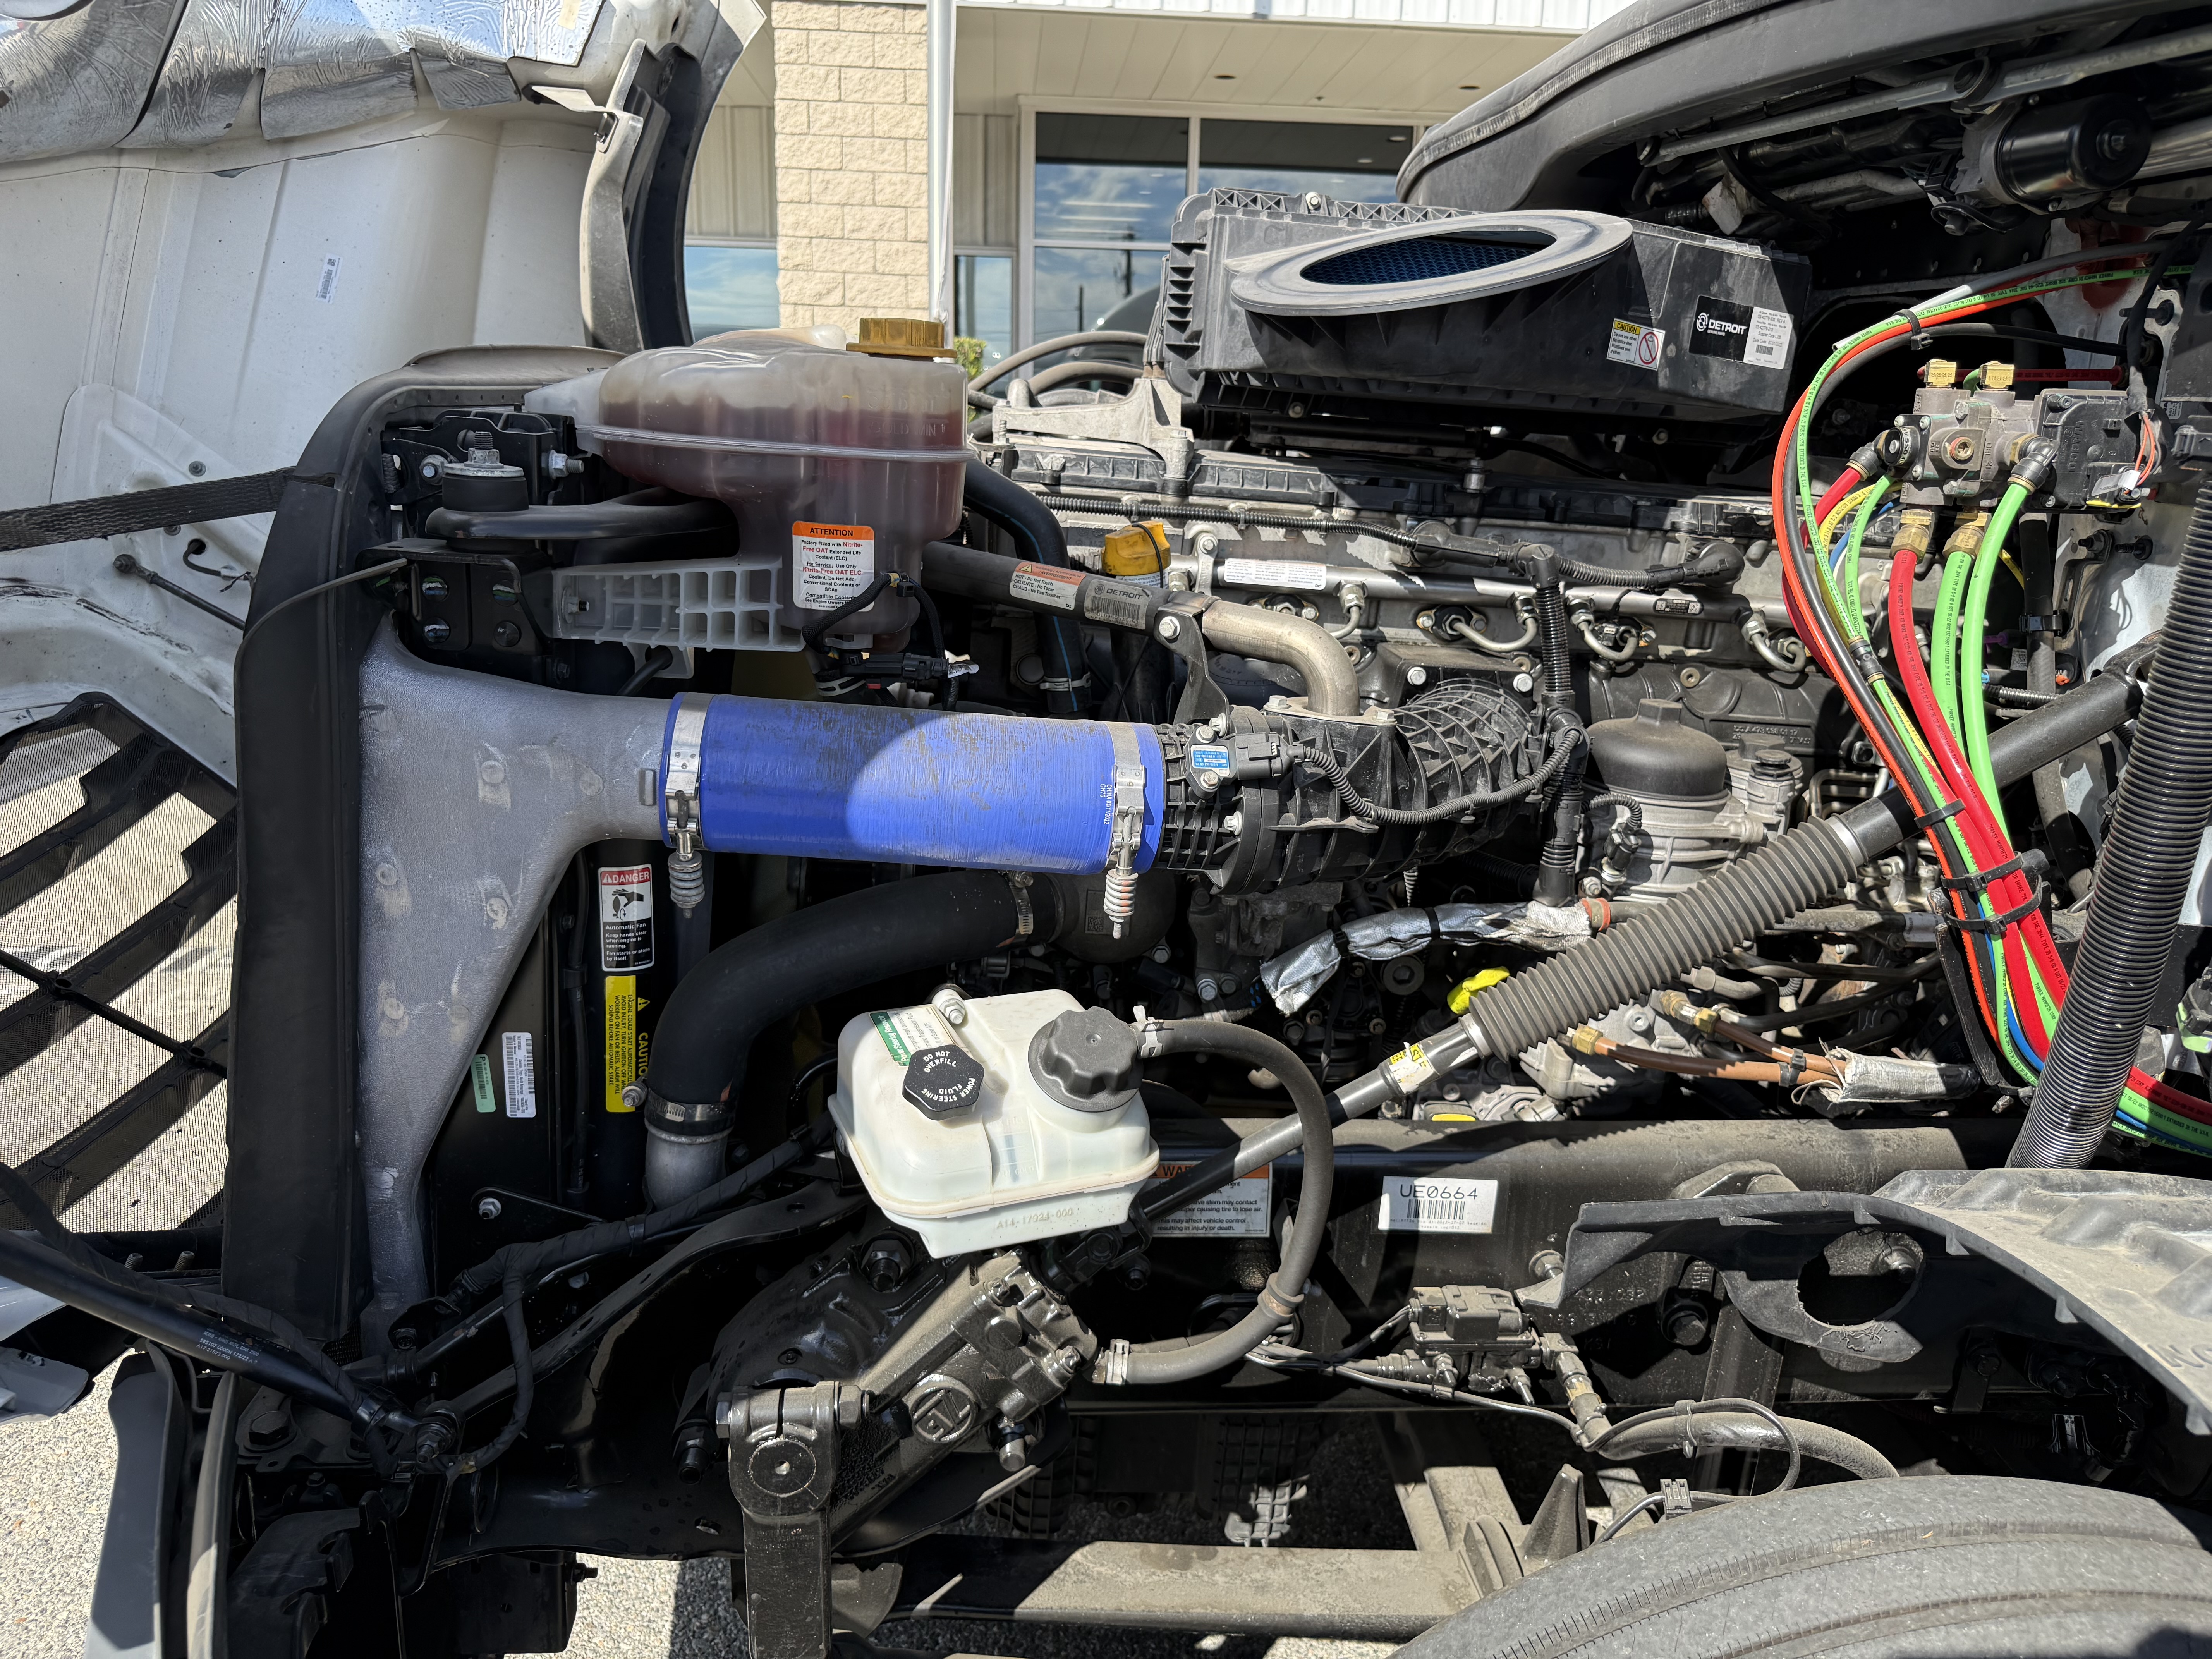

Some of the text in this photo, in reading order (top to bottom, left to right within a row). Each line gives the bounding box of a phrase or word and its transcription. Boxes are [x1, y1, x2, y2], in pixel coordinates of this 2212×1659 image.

[1617, 323, 1637, 333] CAUTION
[1708, 319, 1748, 335] DETROIT
[2068, 421, 2085, 472] WABCO
[810, 528, 853, 536] ATTENTION
[1014, 579, 1034, 587] CALIENTE
[1106, 588, 1143, 600] DETROIT
[1104, 800, 1112, 824] 03/11/2022
[613, 871, 649, 883] DANGER
[615, 1021, 620, 1030] ON
[878, 1015, 893, 1033] Reservoir
[888, 1032, 902, 1049] Steering
[638, 1032, 648, 1077] CAUTIO
[923, 1054, 933, 1062] DO
[924, 1058, 957, 1073] OVERFILL
[921, 1077, 975, 1102] POWER STEERING
[939, 1083, 963, 1095] FLUID
[1400, 1184, 1478, 1200] UE0664
